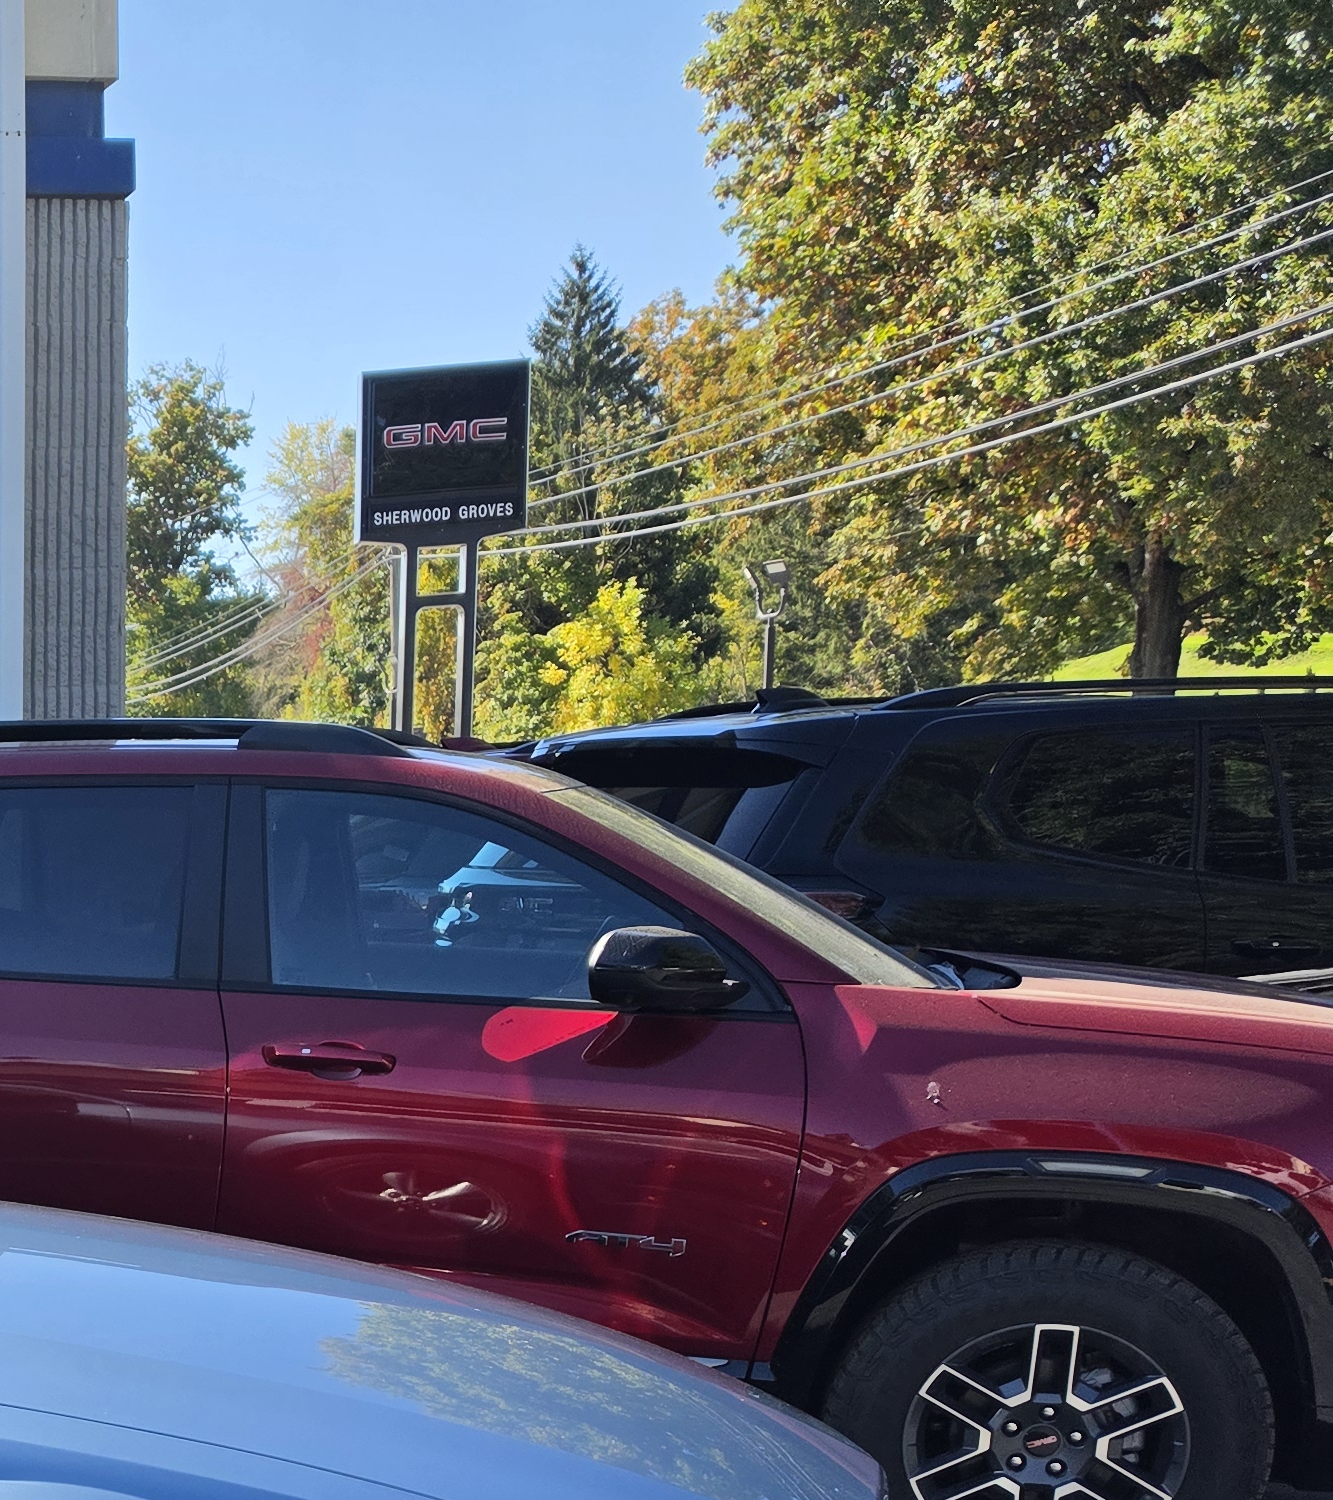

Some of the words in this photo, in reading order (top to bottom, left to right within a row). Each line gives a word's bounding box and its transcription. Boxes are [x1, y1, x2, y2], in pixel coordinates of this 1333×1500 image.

[383, 417, 508, 449] GMC
[373, 506, 451, 526] SHERWOOD
[458, 502, 514, 520] GROVES
[564, 1229, 687, 1258] AT4
